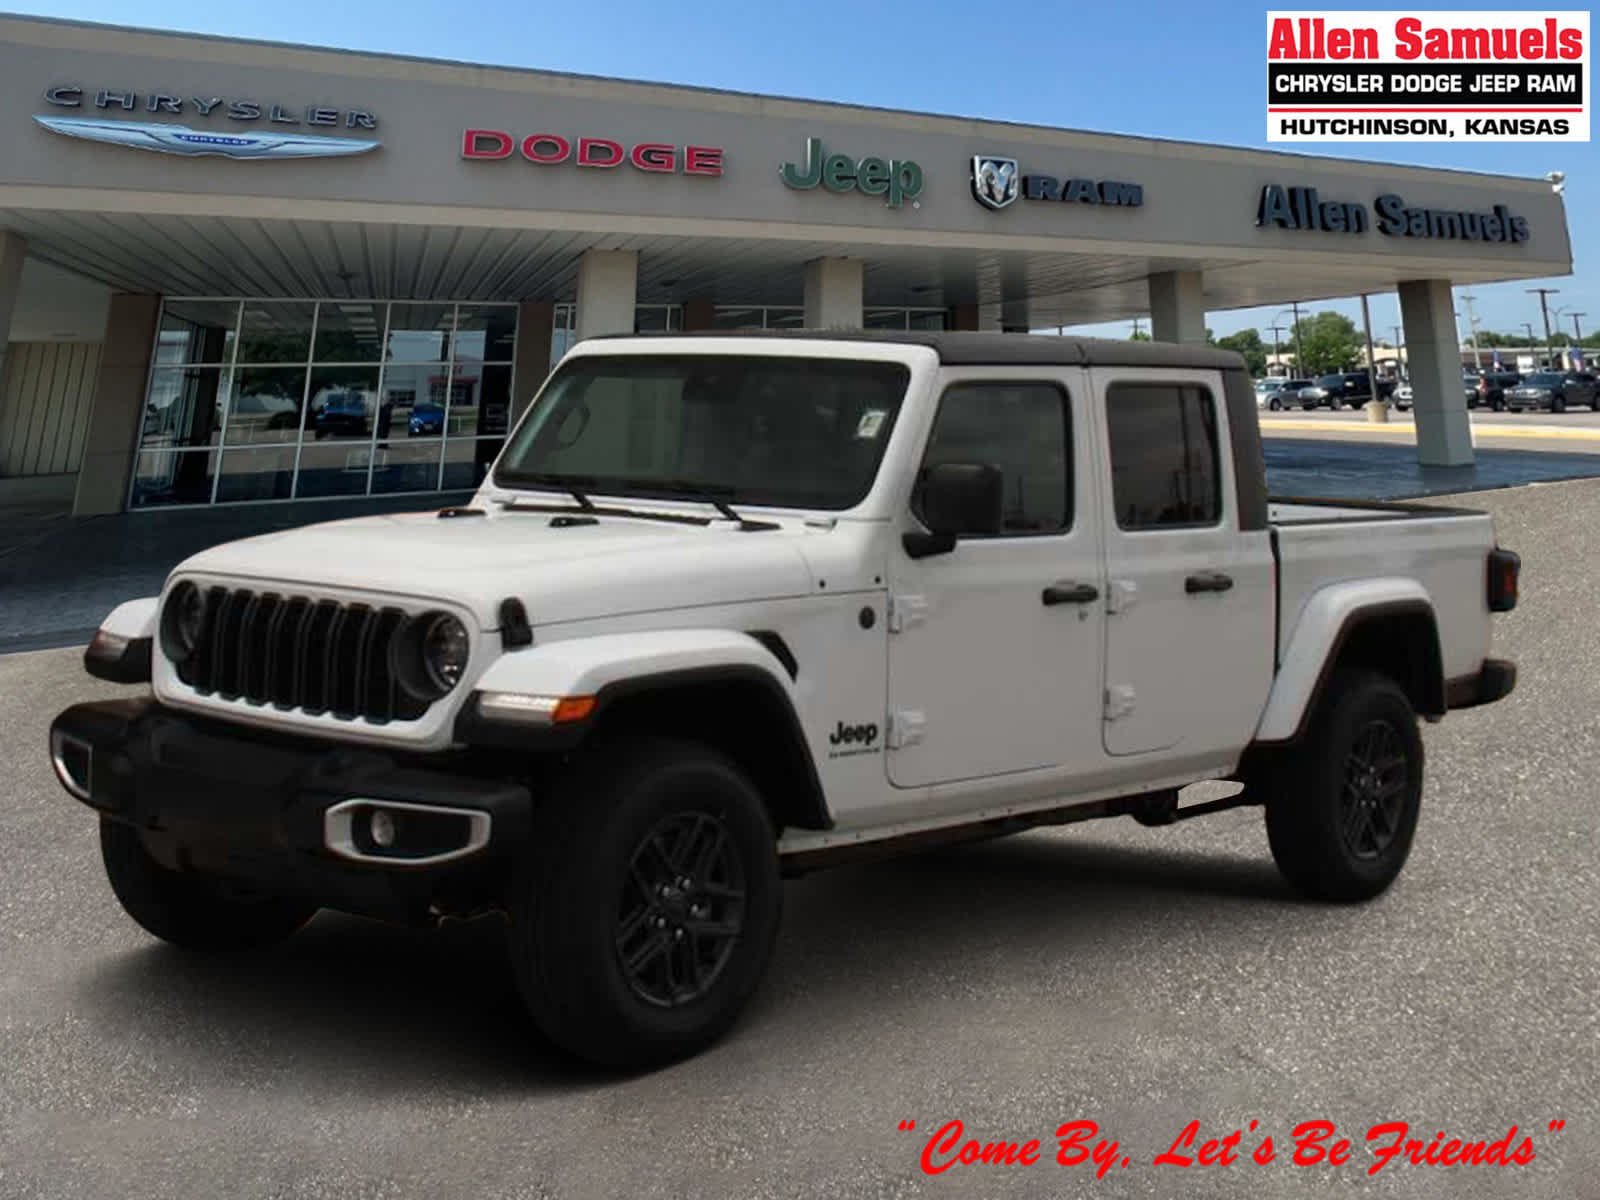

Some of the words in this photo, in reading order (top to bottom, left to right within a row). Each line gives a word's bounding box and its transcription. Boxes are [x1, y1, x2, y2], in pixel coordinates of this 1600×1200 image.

[44, 86, 378, 129] CHRYSLER
[461, 127, 724, 176] DODGE
[778, 136, 924, 209] Jeep
[1022, 175, 1144, 208] RAM
[1255, 184, 1368, 233] Allen
[1374, 193, 1530, 243] Samuels
[829, 720, 878, 746] Jeep
